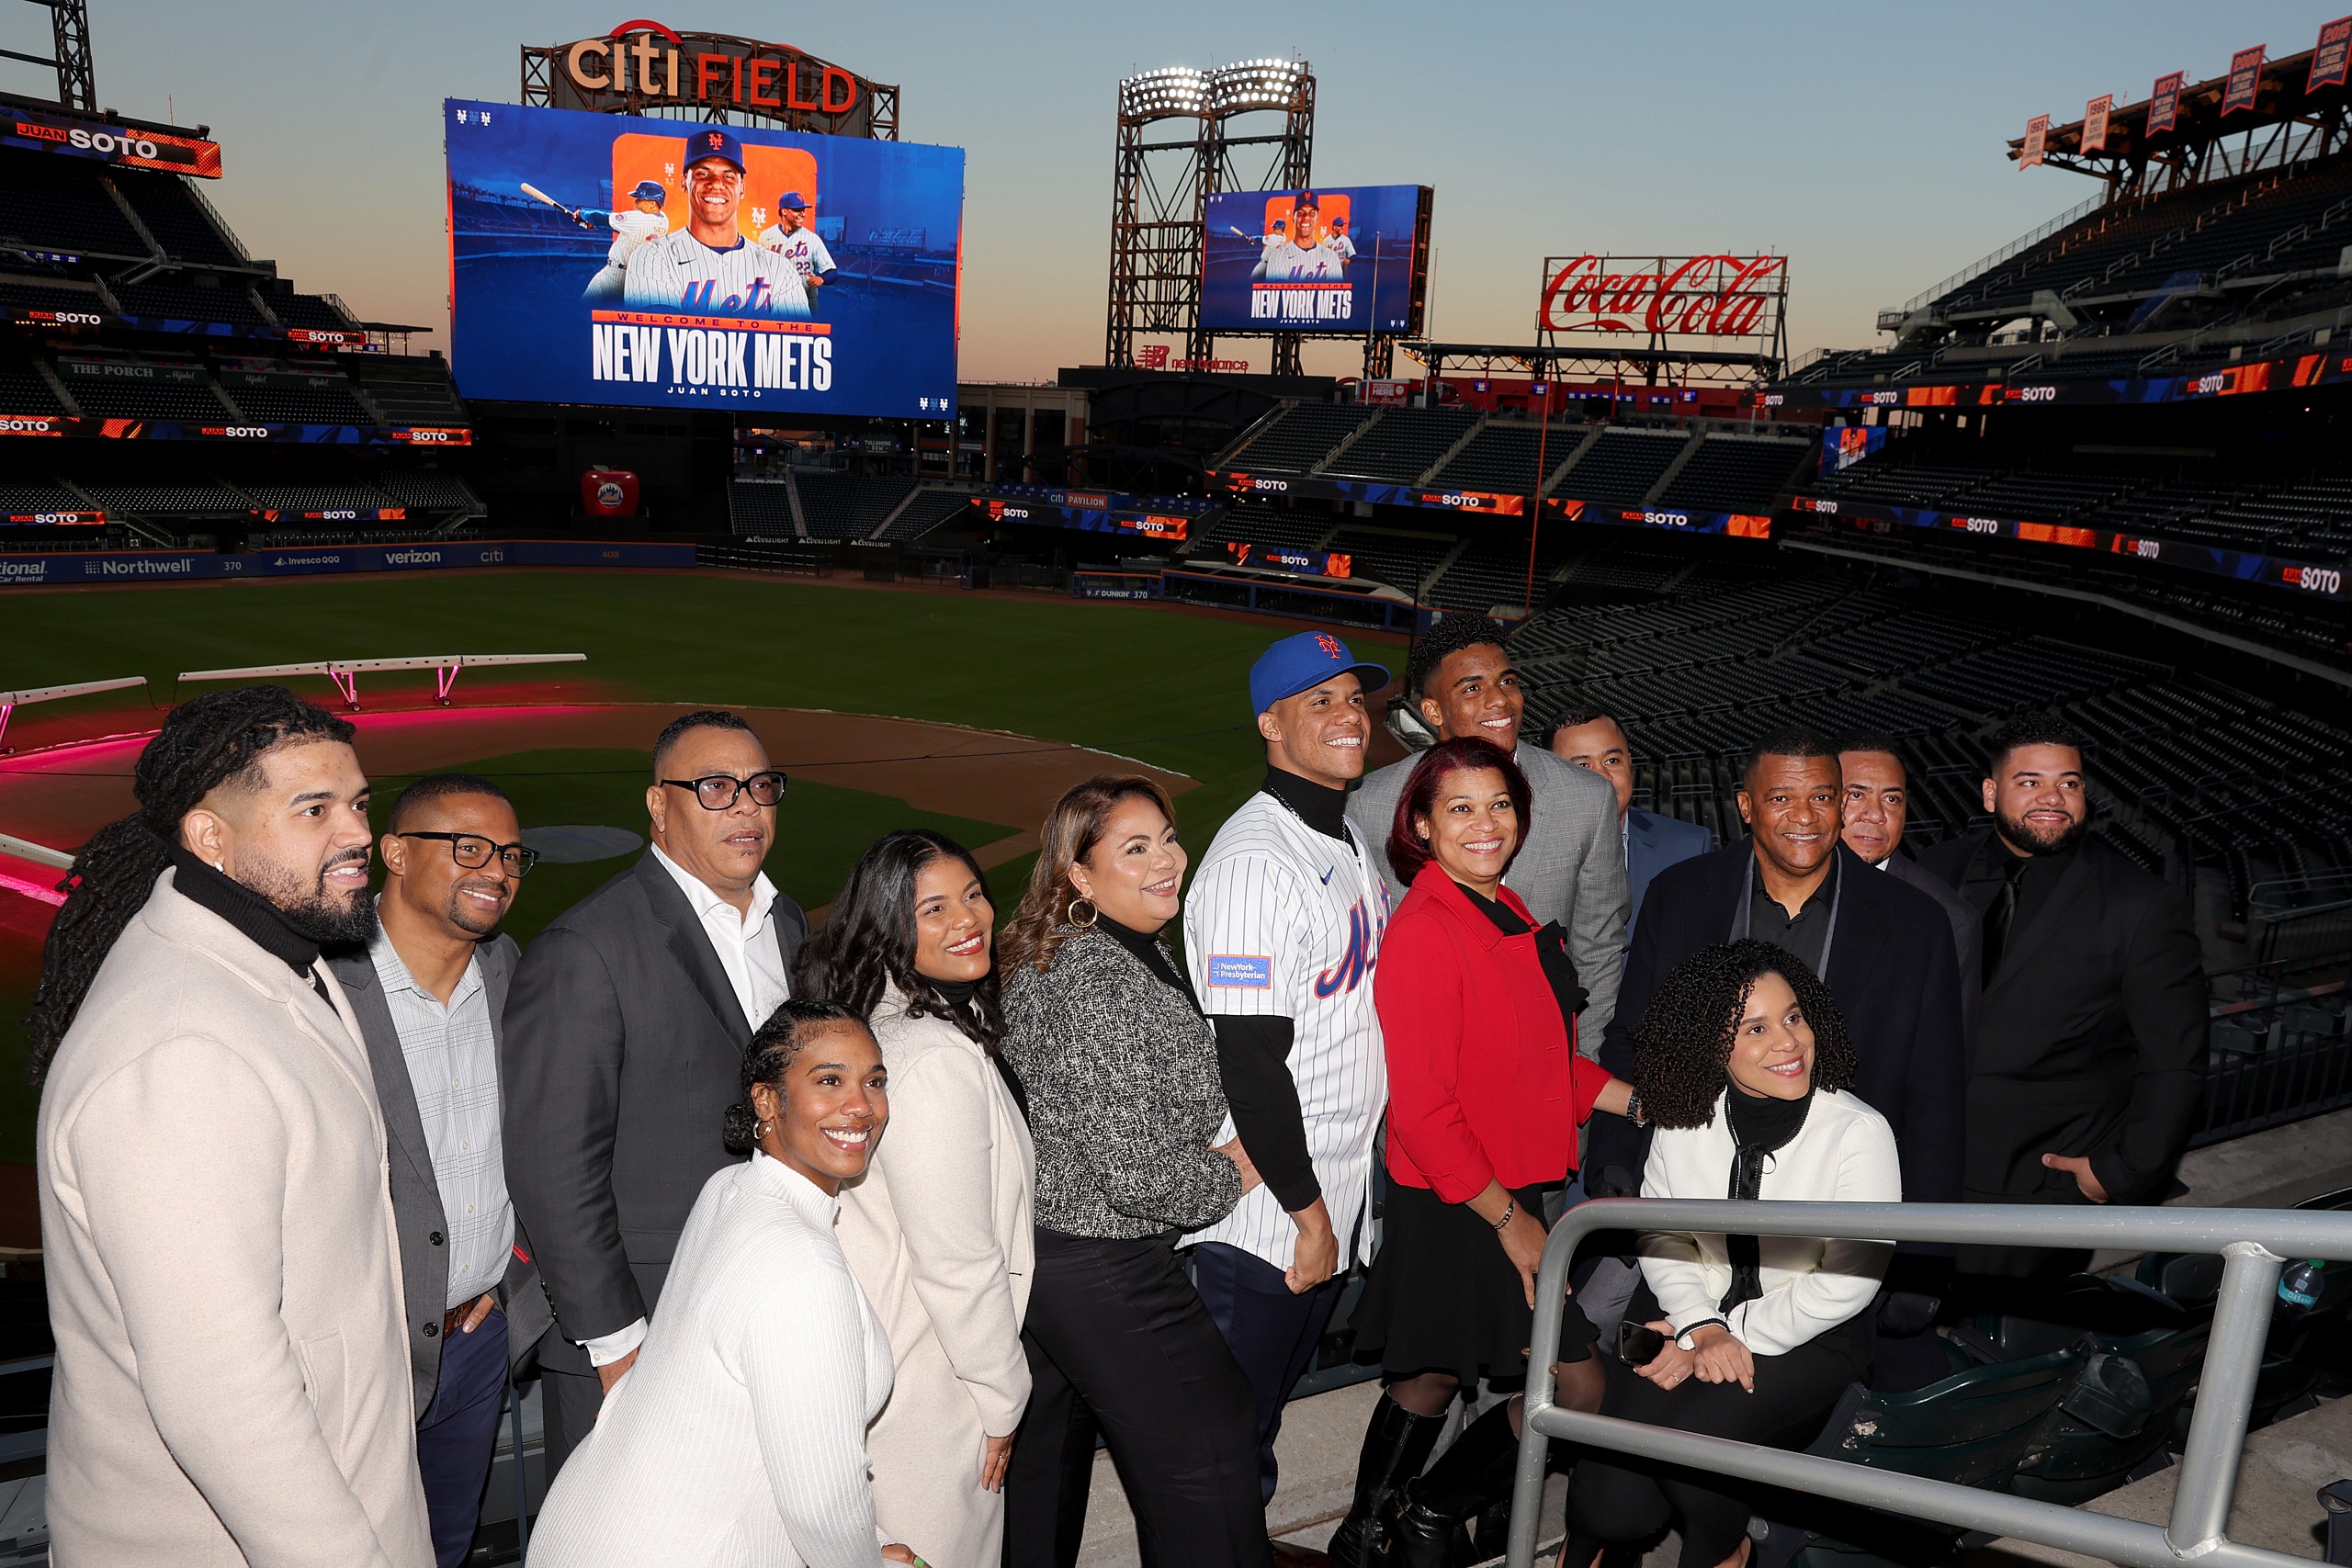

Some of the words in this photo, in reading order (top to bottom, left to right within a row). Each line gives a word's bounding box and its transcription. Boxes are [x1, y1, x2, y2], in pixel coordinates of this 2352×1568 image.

[2323, 21, 2351, 44] 2015
[2233, 51, 2260, 72] 2000
[569, 33, 678, 96] citi
[698, 52, 857, 113] FIELD
[2090, 100, 2107, 116] 1986
[2030, 120, 2044, 133] 1969
[19, 125, 64, 141] JUAN
[69, 129, 157, 159] SOTO
[681, 277, 771, 314] Mets
[1540, 254, 1788, 334] Coca-Cola
[1251, 290, 1280, 318] NEW
[1282, 290, 1316, 319] YORK
[1317, 290, 1352, 319] METS
[55, 312, 101, 324] SOTO
[617, 313, 719, 326] WELCOME
[737, 321, 760, 329] TO
[776, 323, 813, 332] THE
[308, 332, 344, 343] SOTO
[593, 324, 662, 383] NEW
[667, 328, 748, 388] YORK
[754, 333, 831, 391] METS
[1171, 358, 1194, 369] new
[1198, 356, 1249, 370] balance
[72, 364, 101, 375] THE
[104, 366, 153, 378] PORCH
[2199, 375, 2223, 393] SOTO
[667, 386, 708, 396] JUAN
[720, 389, 762, 398] SOTO
[1872, 391, 1898, 403] SOTO
[2021, 387, 2055, 400] SOTO
[1765, 395, 1783, 405] SOTO
[0, 420, 49, 431] SOTO
[225, 427, 267, 438] SOTO
[413, 432, 447, 441] SOTO
[1255, 479, 1287, 491] SOTO
[1050, 493, 1064, 503] citi
[1069, 496, 1104, 507] PAVILION
[1442, 495, 1479, 507] SOTO
[1003, 508, 1028, 518] SOTO
[1815, 501, 1838, 513] SOTO
[35, 514, 77, 524] SOTO
[322, 511, 356, 519] SOTO
[1623, 511, 1644, 520] JUAN
[1645, 512, 1687, 526] SOTO
[1136, 521, 1164, 532] SOTO
[1967, 517, 1997, 535] SOTO
[481, 549, 503, 562] citi
[2138, 540, 2159, 559] SOTO
[288, 557, 321, 566] Invesco
[322, 556, 340, 564] QQQ
[386, 549, 441, 564] verizon
[1281, 556, 1308, 566] SOTO
[103, 558, 191, 575] Northwell
[224, 562, 242, 570] 370
[2301, 568, 2341, 594] SOTO
[1134, 591, 1148, 599] 370
[1185, 599, 1218, 608] CADILLAC
[1342, 620, 1381, 630] CADILLAC
[1221, 971, 1266, 980] Presbyterian
